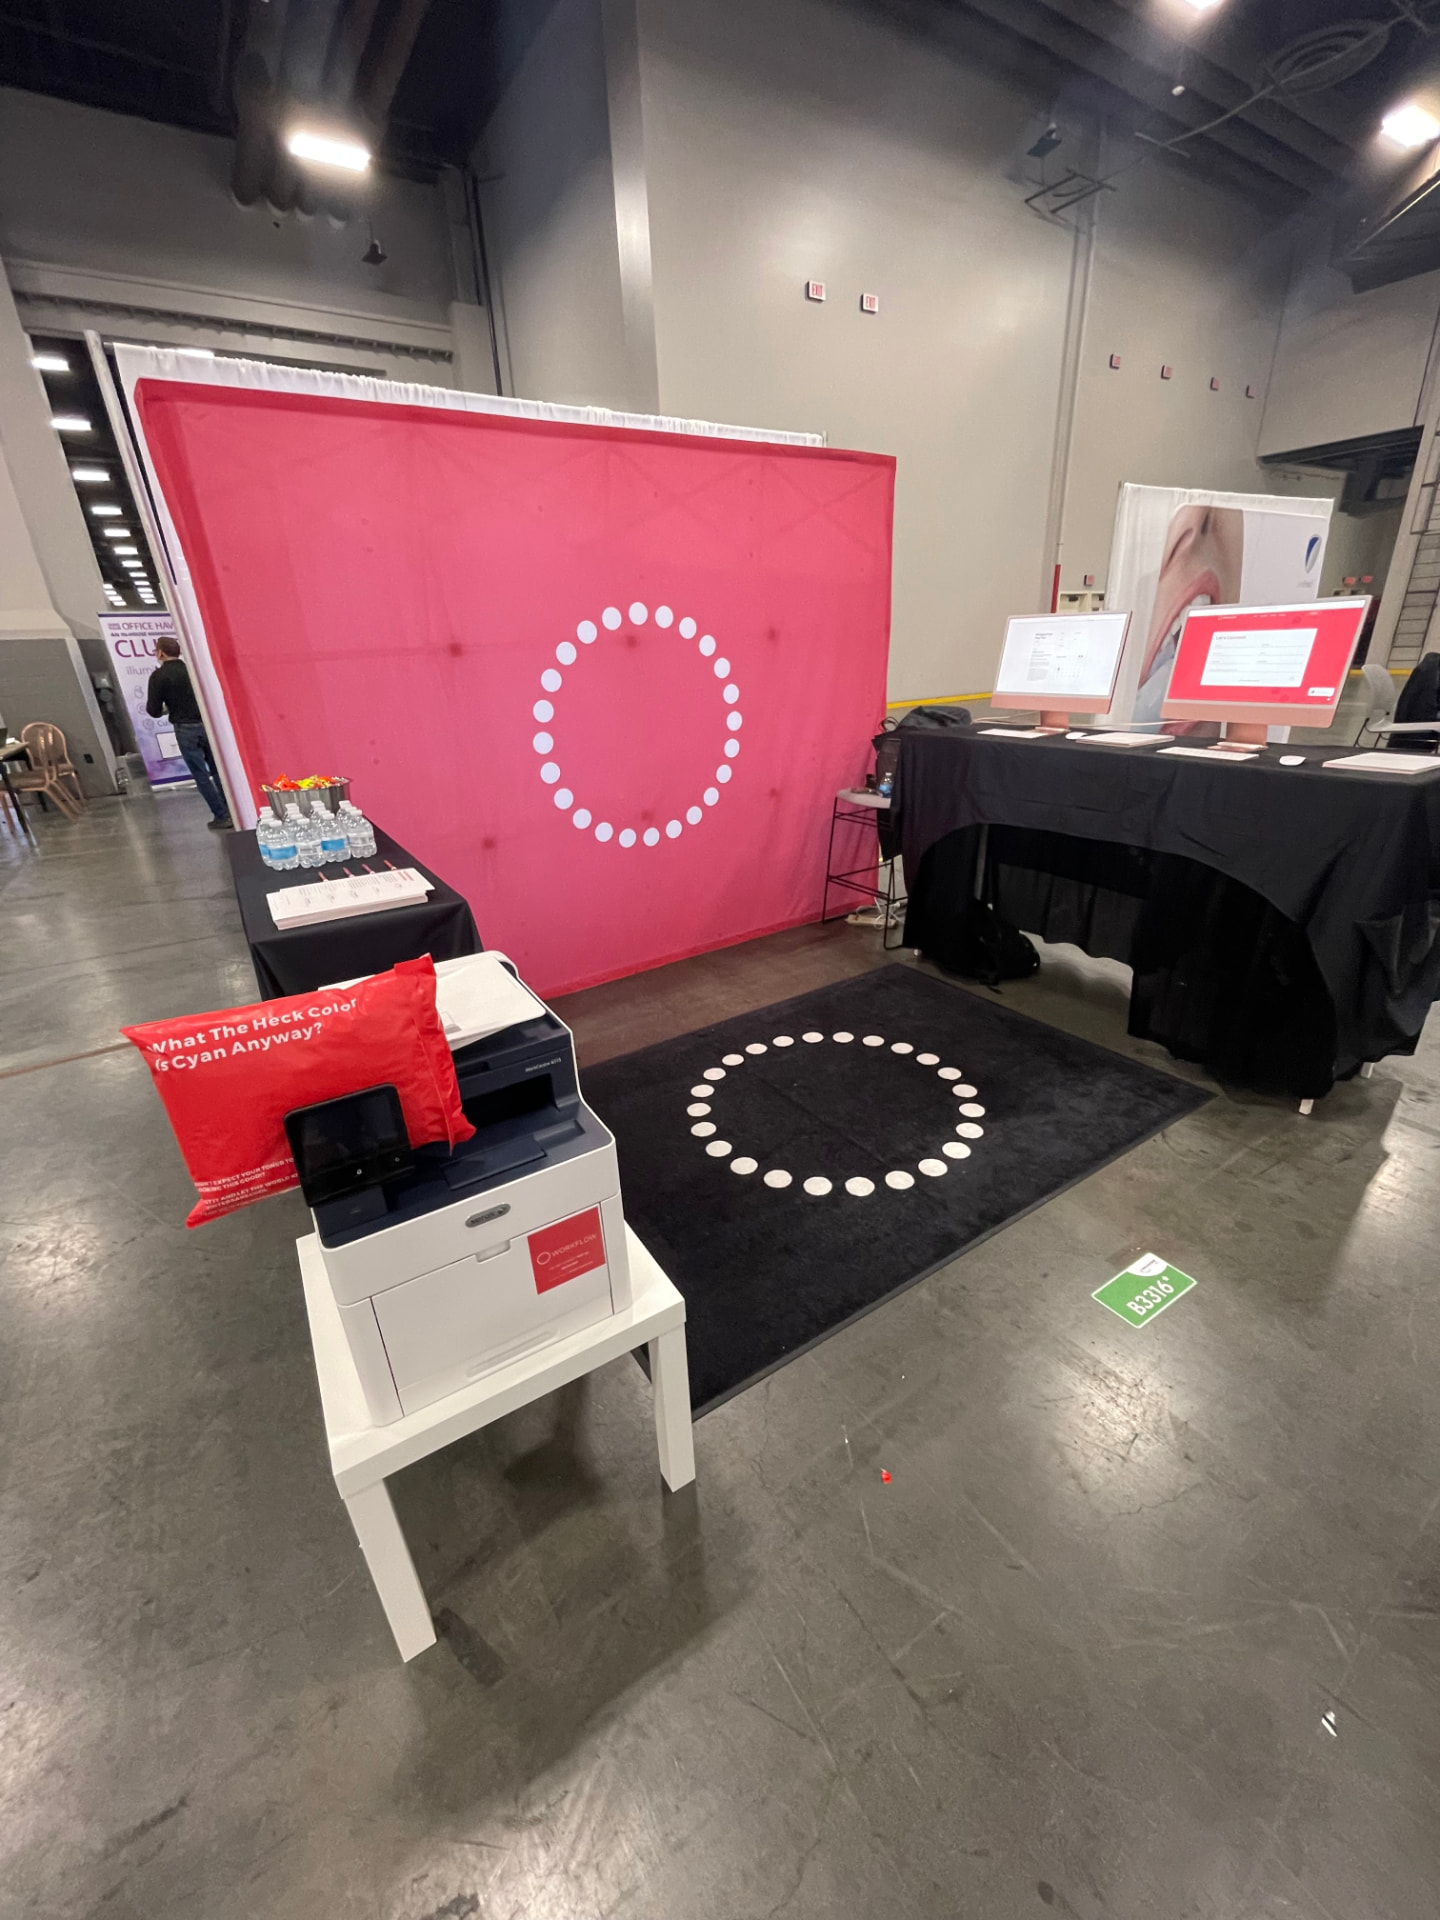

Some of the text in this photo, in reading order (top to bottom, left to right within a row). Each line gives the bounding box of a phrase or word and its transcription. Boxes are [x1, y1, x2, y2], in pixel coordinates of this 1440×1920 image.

[811, 282, 823, 298] EXIT
[865, 295, 876, 310] EXIT
[122, 621, 153, 630] OFFICE
[147, 997, 359, 1053] What The Heck Color
[172, 1046, 227, 1070] Cyan
[231, 1021, 324, 1056] Anyway?
[213, 1174, 240, 1186] EXPECT
[241, 1167, 261, 1177] YOUR
[223, 1180, 239, 1188] THIS
[551, 1232, 597, 1257] WORKFLOW
